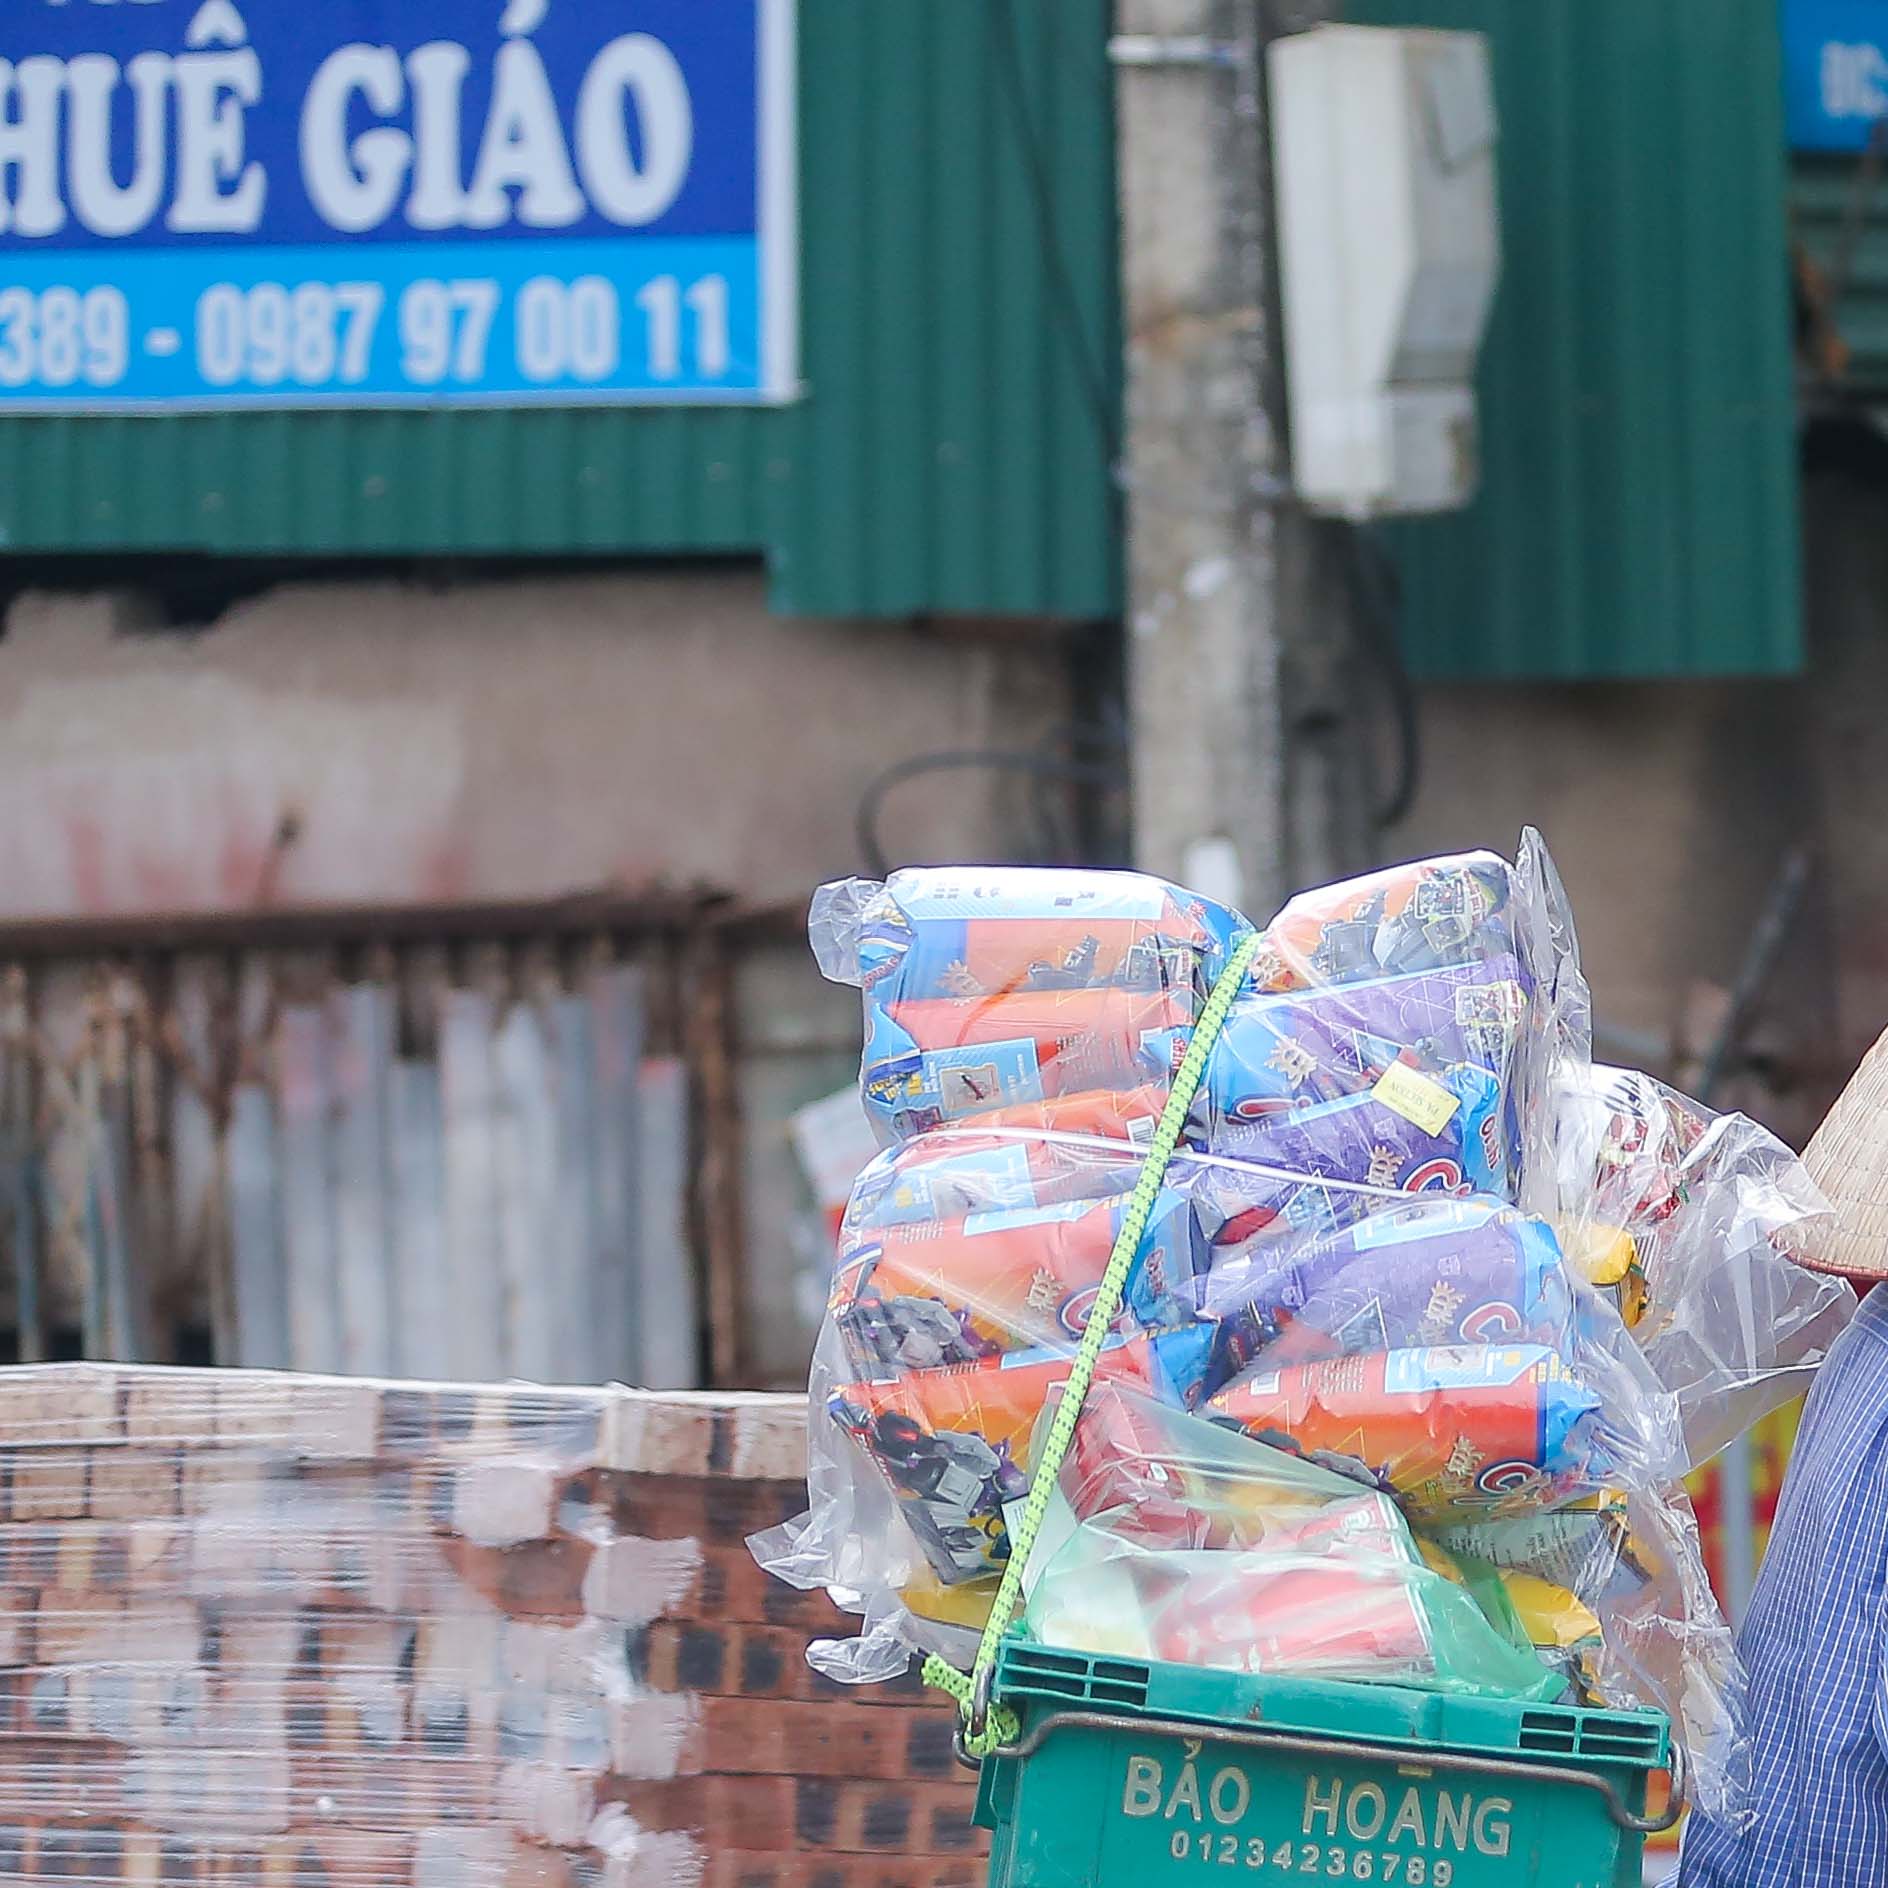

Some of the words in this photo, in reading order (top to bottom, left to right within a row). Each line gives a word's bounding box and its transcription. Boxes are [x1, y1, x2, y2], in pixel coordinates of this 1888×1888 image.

[299, 0, 694, 232] GIÁO
[196, 280, 386, 385] 0987
[400, 277, 498, 384] 97
[516, 274, 619, 382] 00
[635, 273, 729, 381] 11
[1122, 1738, 1252, 1825] BẢO
[1170, 1830, 1454, 1888] 01234236789
